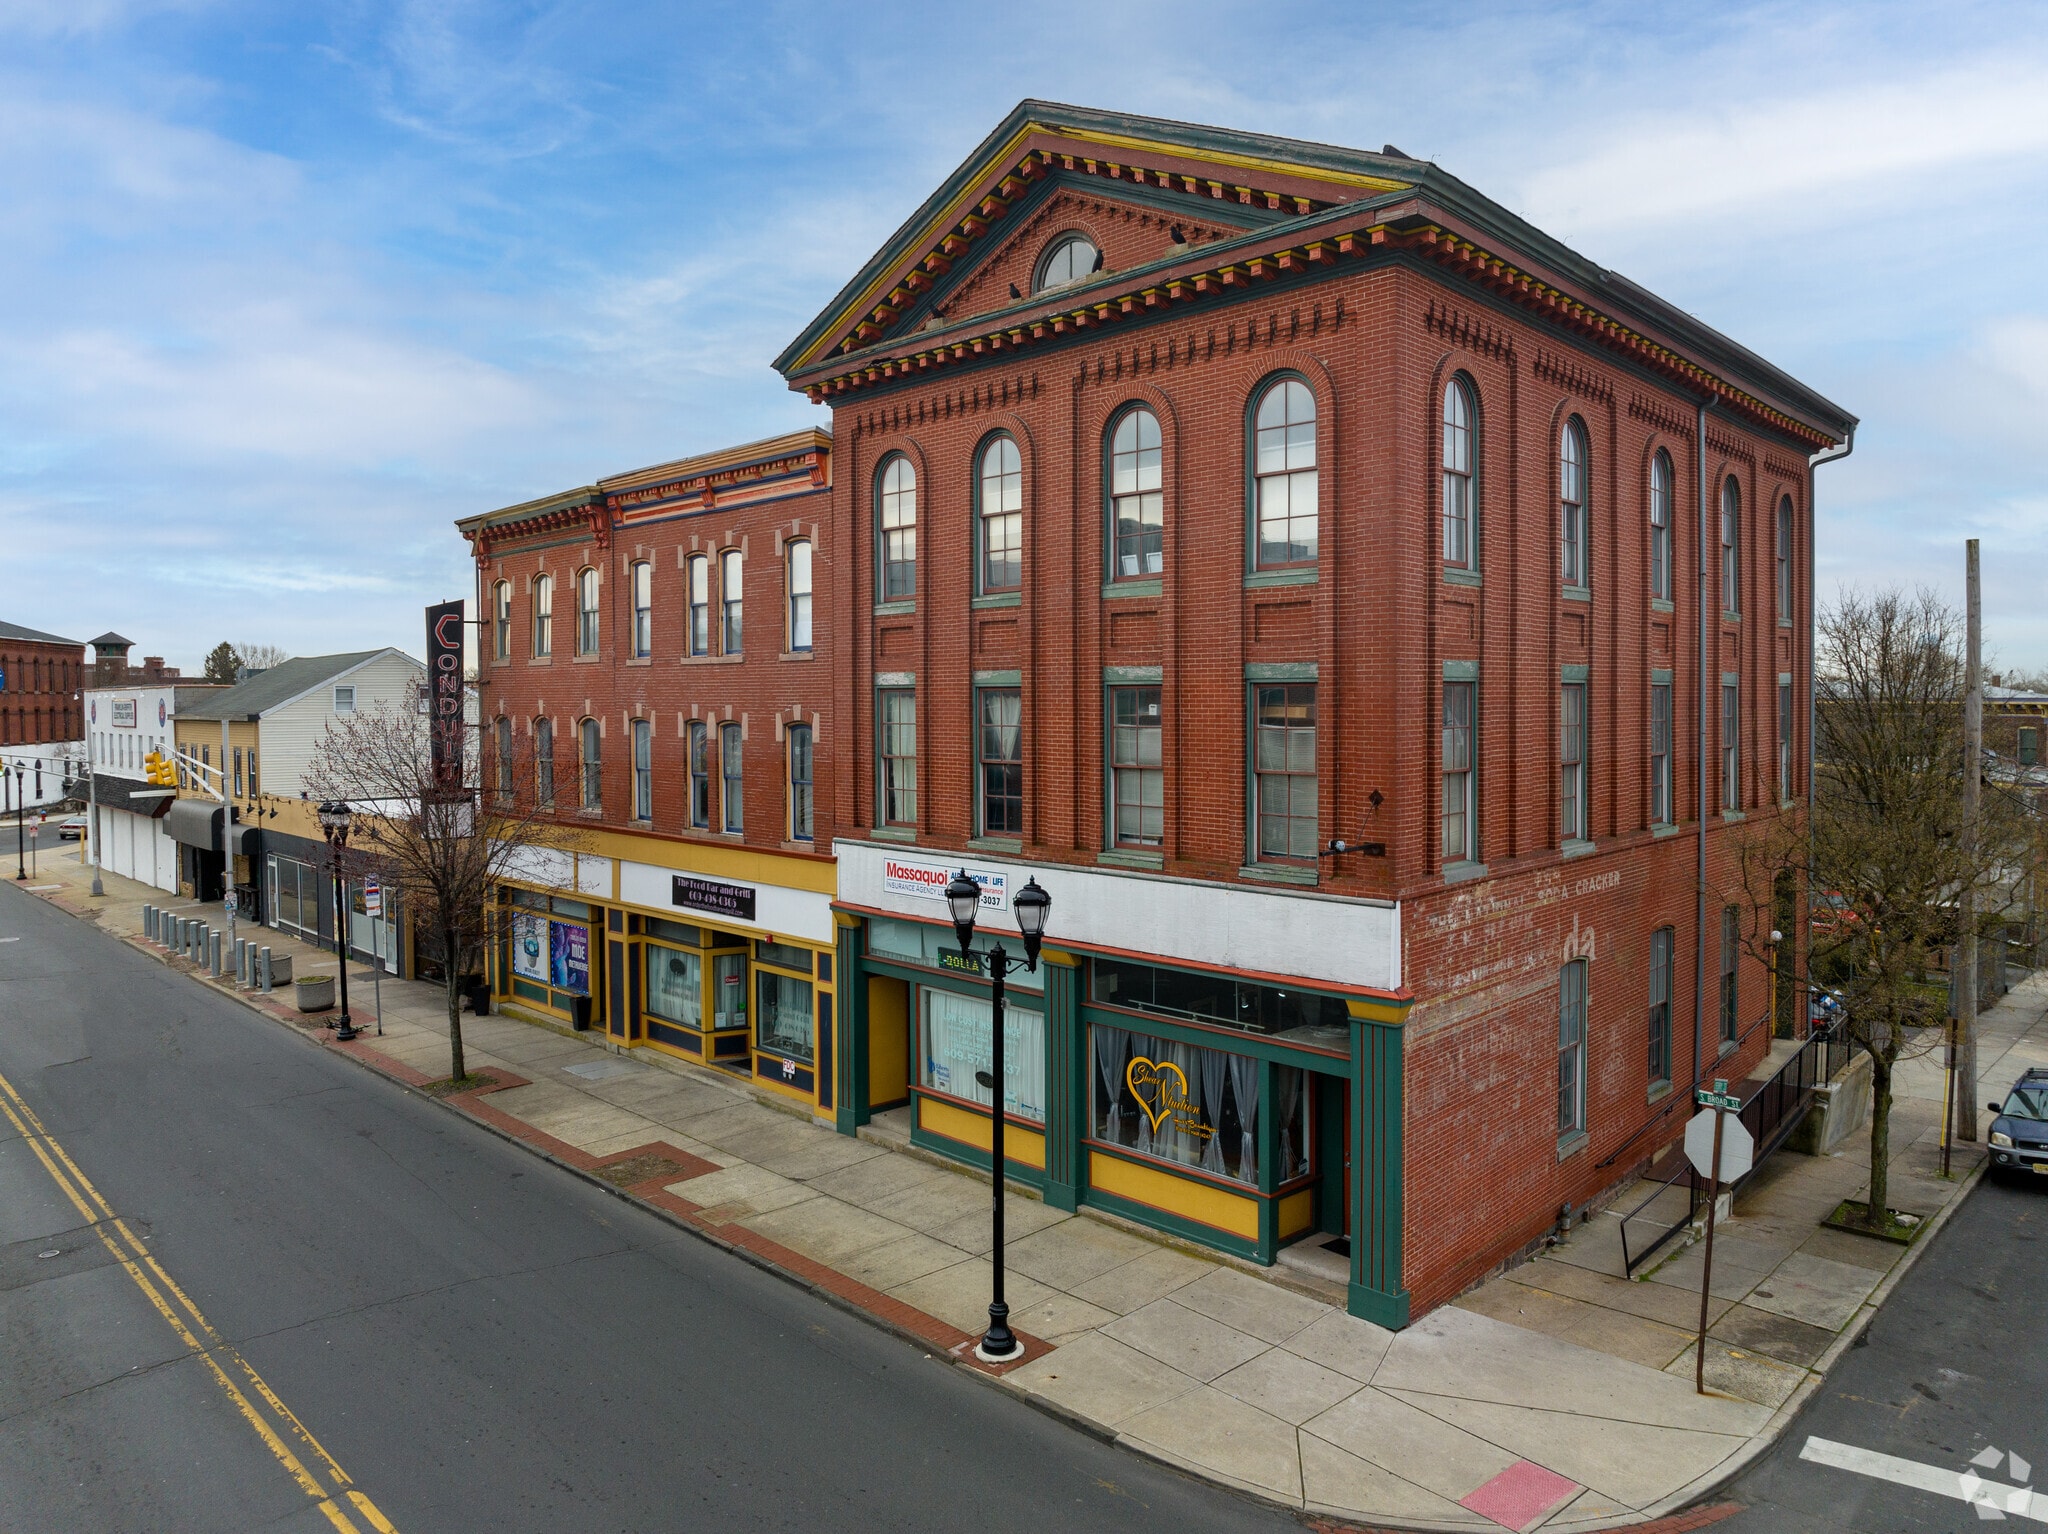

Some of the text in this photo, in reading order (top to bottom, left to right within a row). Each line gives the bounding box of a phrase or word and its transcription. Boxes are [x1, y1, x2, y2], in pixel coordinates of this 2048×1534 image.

[435, 614, 460, 780] CONDUIT
[886, 862, 948, 886] Massaquoi
[970, 874, 988, 884] HOME
[993, 877, 1003, 886] LIFE
[1575, 870, 1621, 895] CRACKER
[677, 878, 751, 899] The Food Bar and Grill
[887, 881, 947, 897] INSURANCE AGENCY LL
[980, 887, 1004, 896] nsurance
[980, 895, 1000, 906] -3037
[571, 943, 585, 960] MOE
[783, 1059, 795, 1072] FDC
[943, 1047, 1020, 1077] 609-571-37
[1133, 1065, 1161, 1085] Shear
[1707, 1095, 1728, 1106] BROAD
